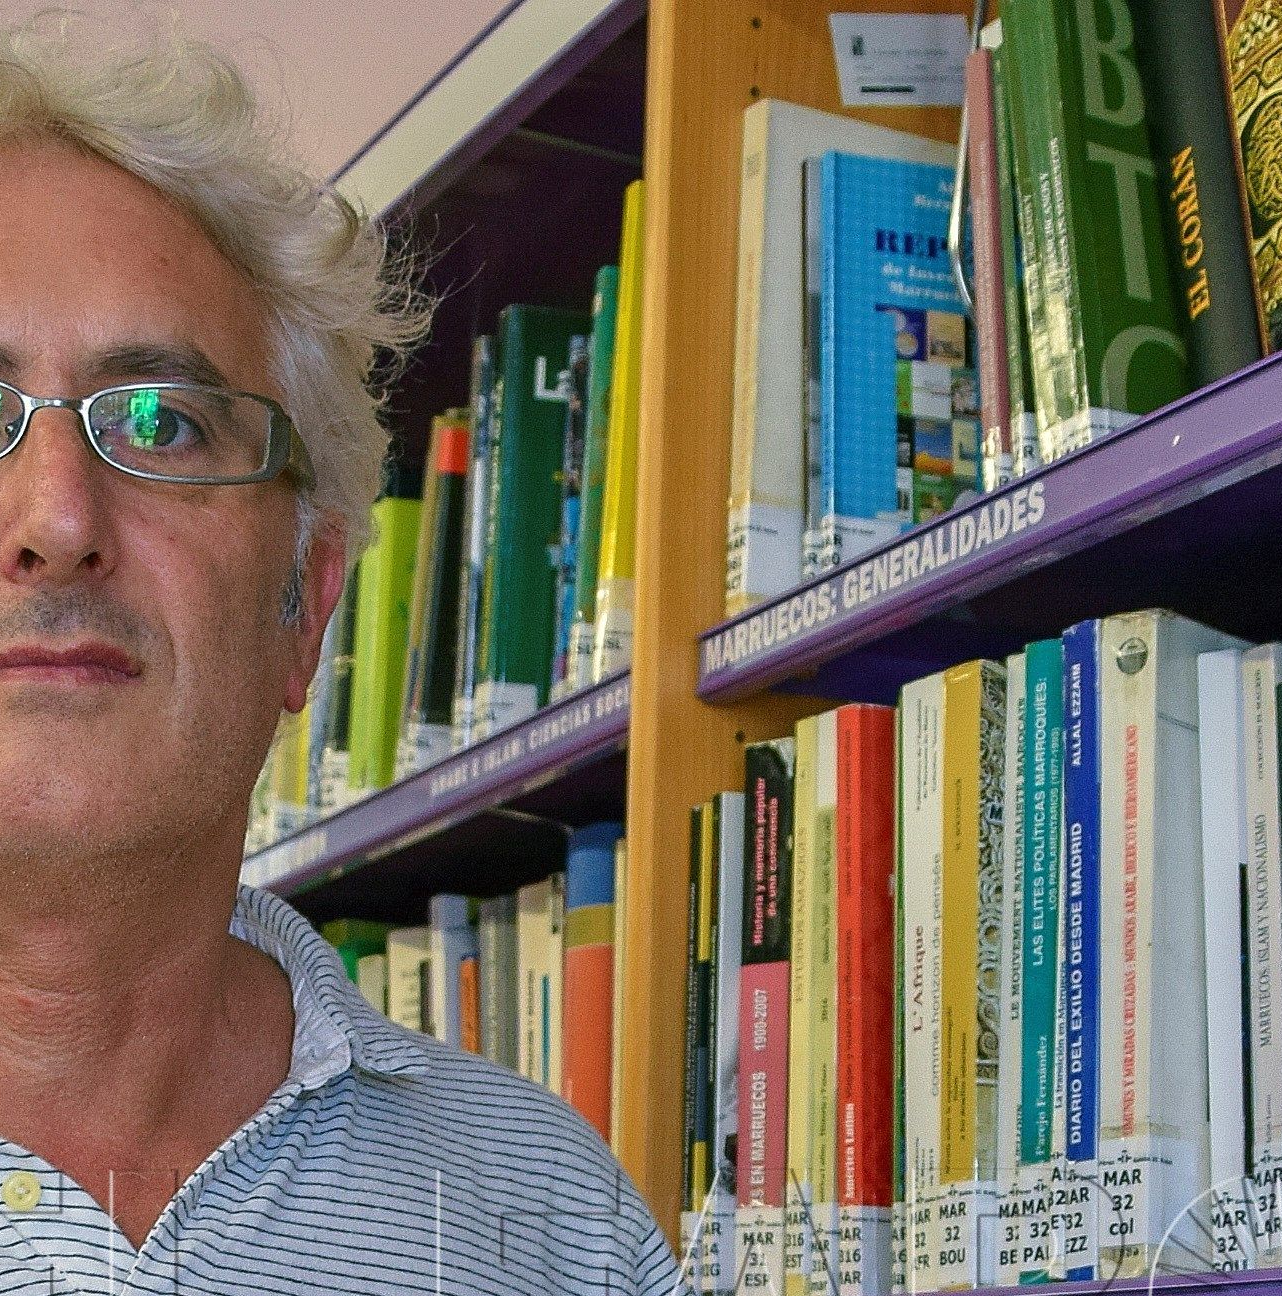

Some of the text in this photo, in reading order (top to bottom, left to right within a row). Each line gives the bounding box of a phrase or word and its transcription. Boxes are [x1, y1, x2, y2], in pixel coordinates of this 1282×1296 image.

[1170, 145, 1210, 319] EL CORÁN
[705, 597, 838, 674] MARRUECOS:
[842, 481, 1046, 611] GENERALIDADES
[1071, 664, 1081, 766] ALLAL EZZAIM
[1031, 791, 1046, 871] POLÍTICAS
[1033, 877, 1045, 930] ELITES
[1033, 935, 1044, 966] LAS
[1071, 822, 1082, 1144] DIARIO DEL EXILIO DESDE MADRID
